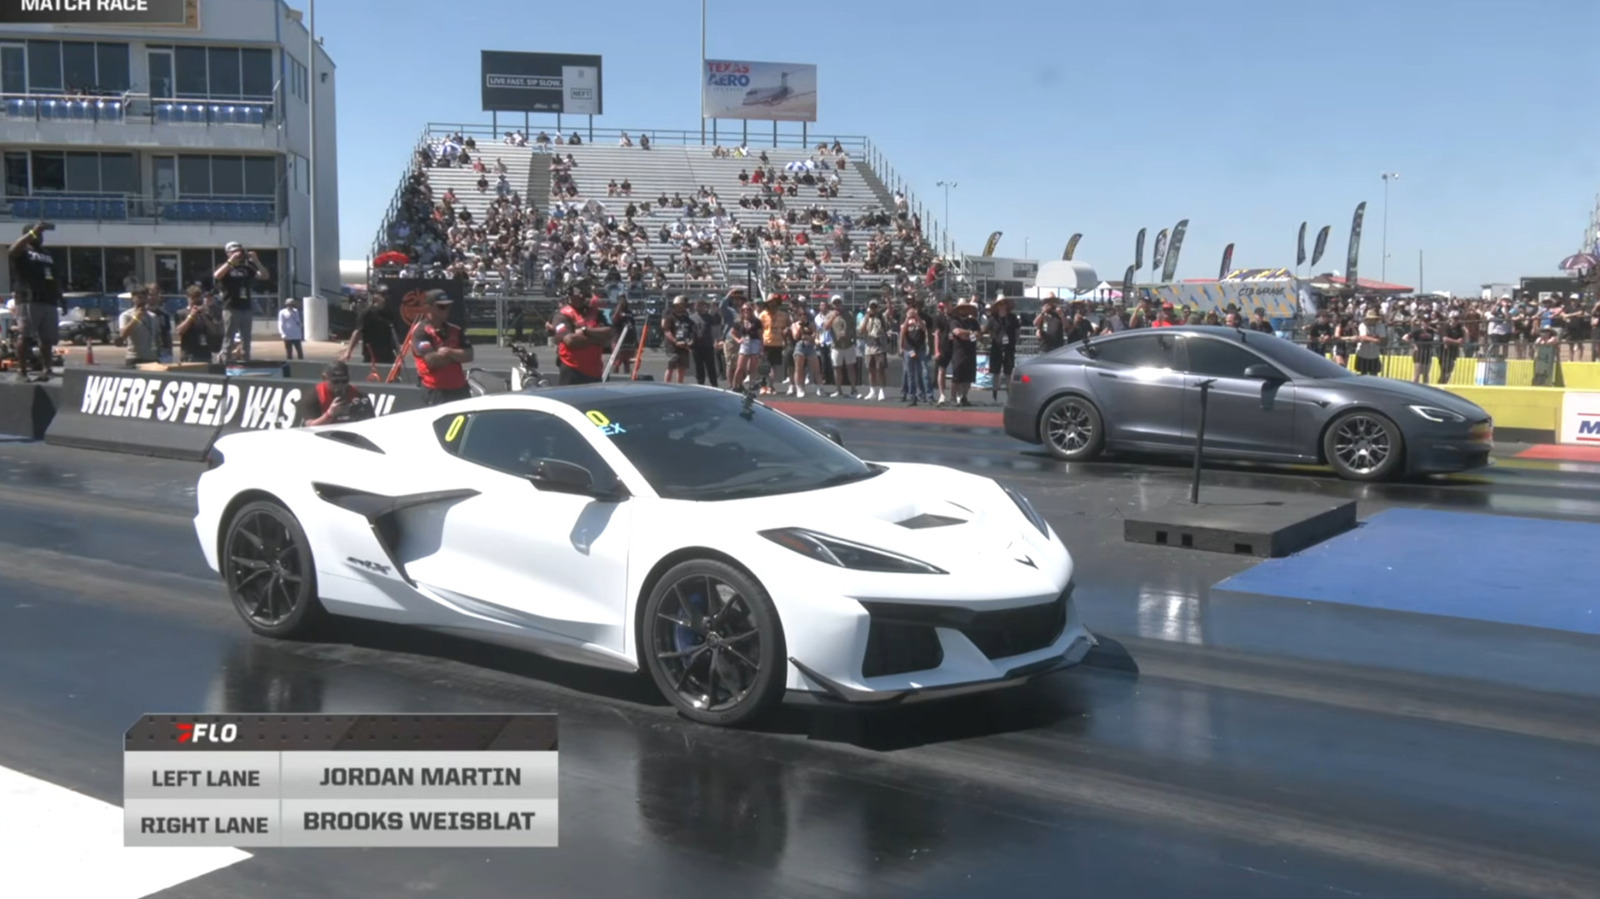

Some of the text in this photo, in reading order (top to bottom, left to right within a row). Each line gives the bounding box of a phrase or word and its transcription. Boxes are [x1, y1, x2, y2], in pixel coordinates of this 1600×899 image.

[708, 62, 750, 74] TEXAS
[490, 77, 505, 85] LIVE
[539, 79, 562, 87] SLOW.
[707, 73, 750, 87] AERO
[81, 375, 301, 429] WHERE SPEED WAS
